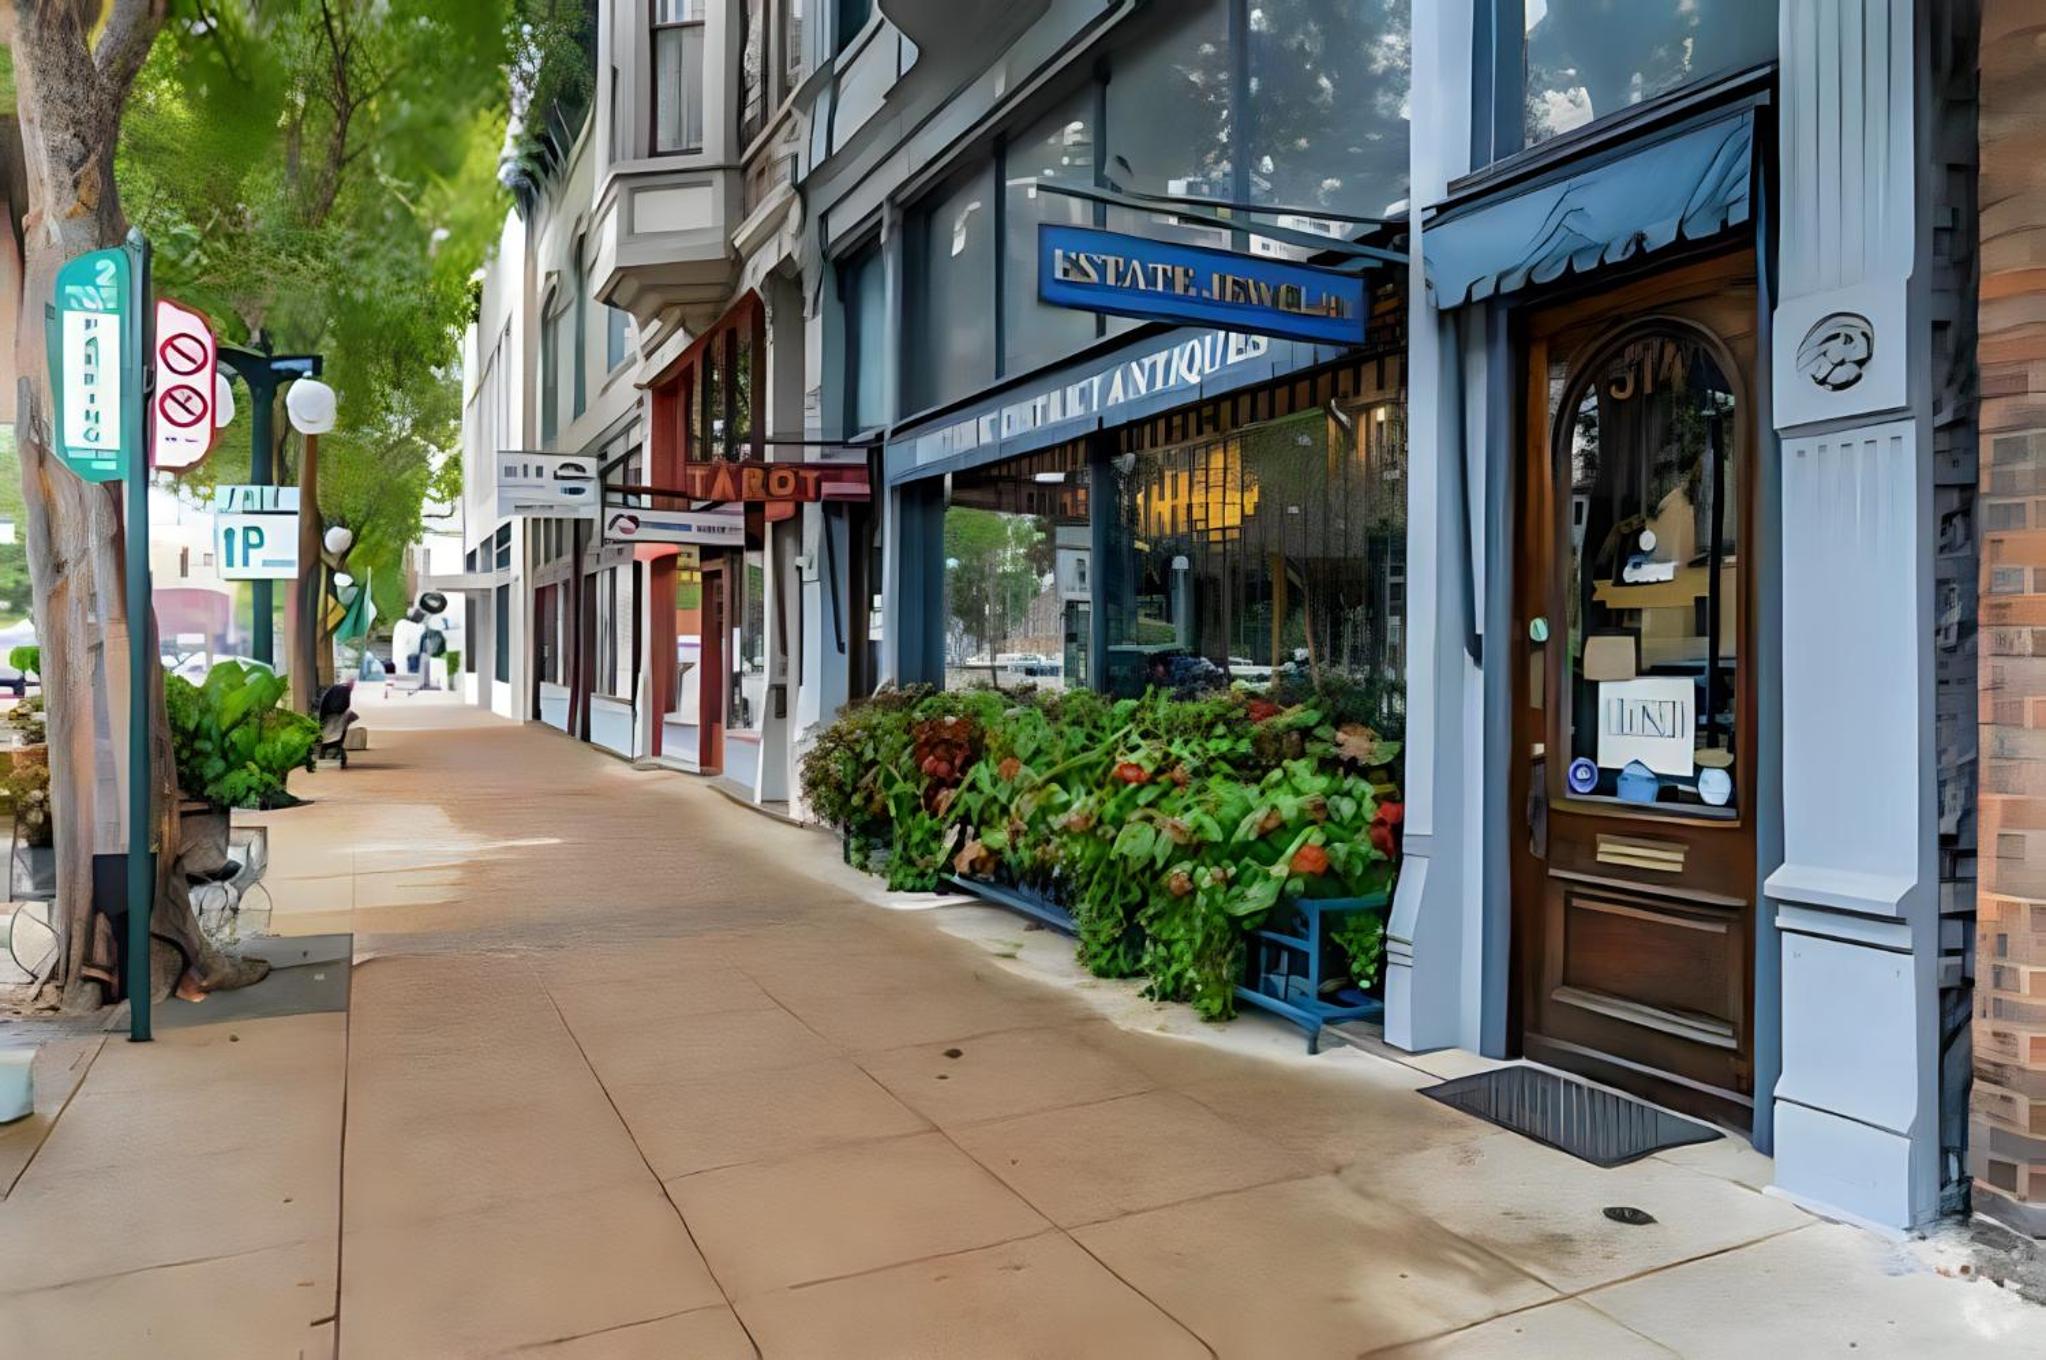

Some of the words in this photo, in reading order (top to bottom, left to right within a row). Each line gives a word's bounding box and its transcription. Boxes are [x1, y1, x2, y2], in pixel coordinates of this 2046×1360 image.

[1054, 249, 1197, 297] ESTATE
[1106, 331, 1270, 407] ANTIQUES
[686, 458, 819, 501] TAROT
